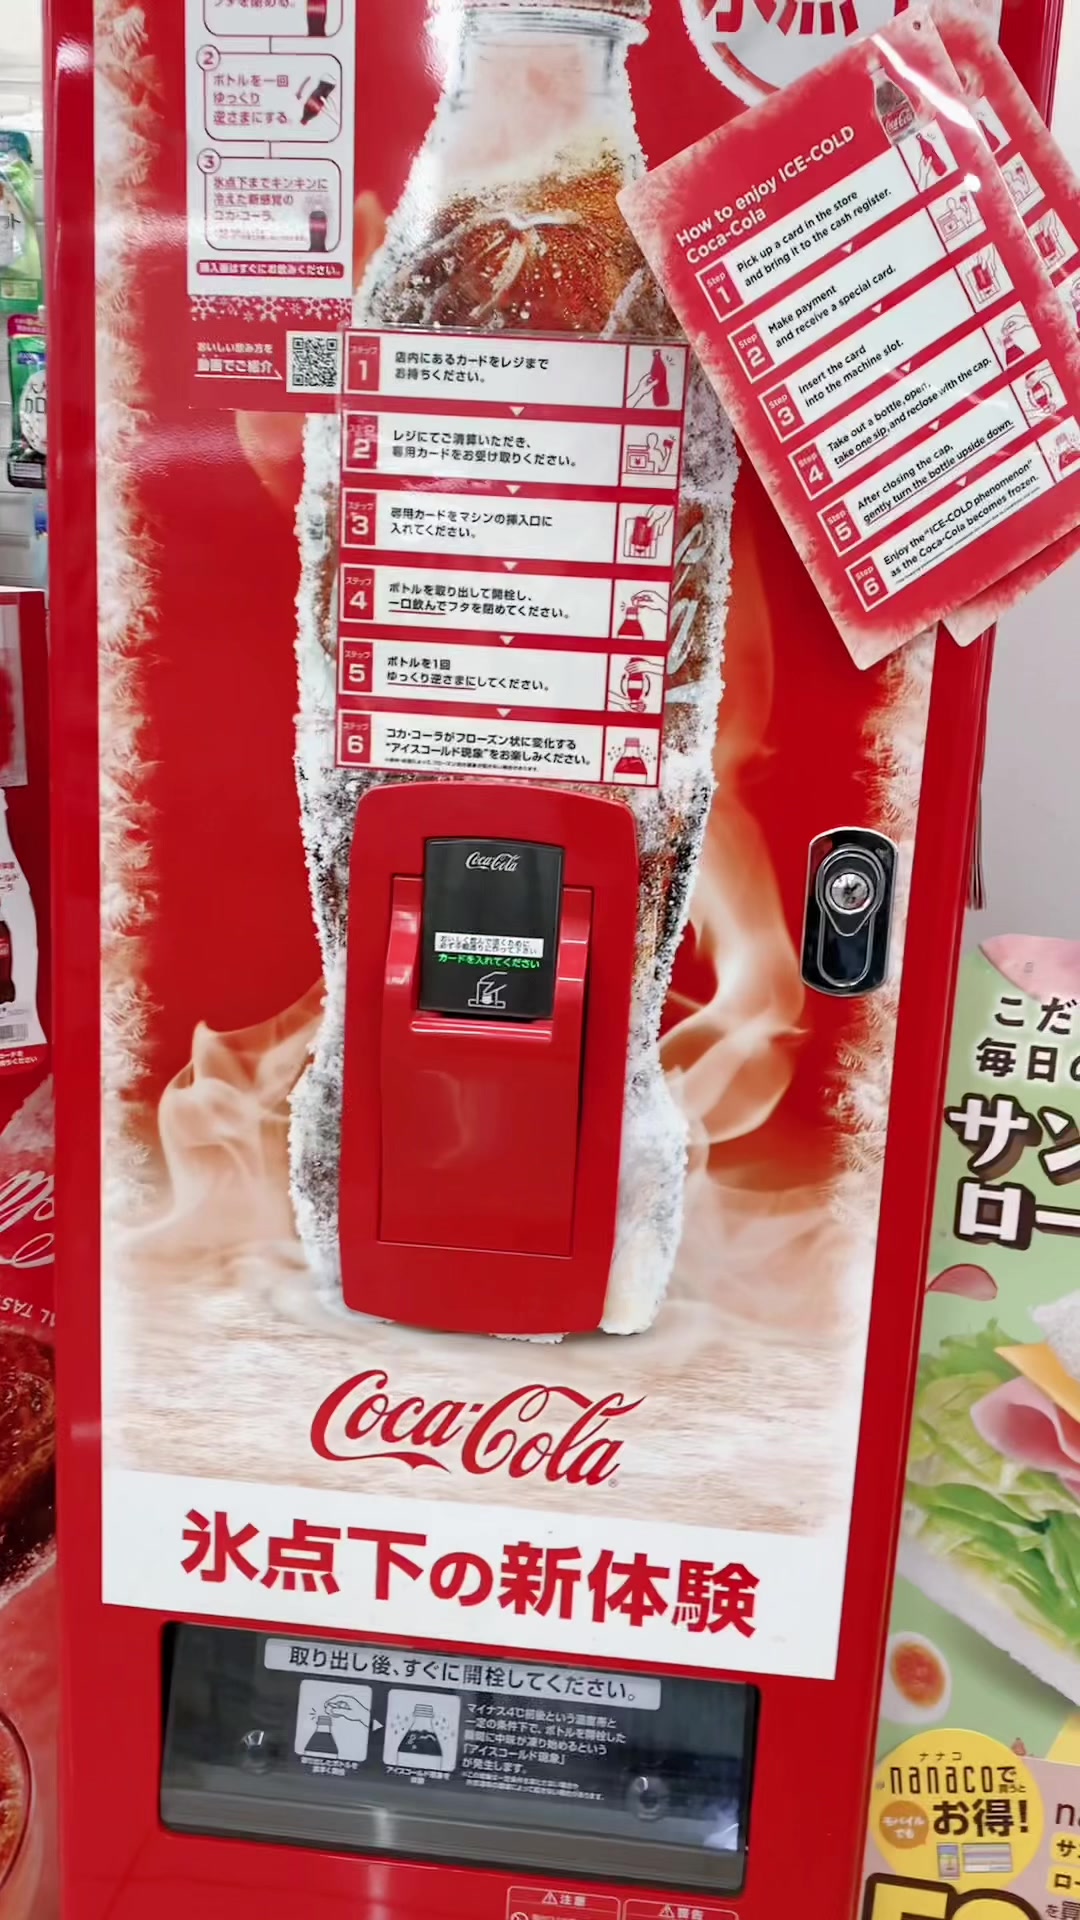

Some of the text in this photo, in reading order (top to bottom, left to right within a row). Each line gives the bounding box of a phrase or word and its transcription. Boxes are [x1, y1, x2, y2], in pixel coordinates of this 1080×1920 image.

[203, 51, 214, 65] 2
[213, 75, 289, 87] ボトルを一回
[213, 92, 260, 104] ゆっくり
[203, 155, 215, 169] 3
[214, 176, 329, 190] 氷点下までキンキンに
[675, 125, 854, 247] How to enjoy ICE-COLD
[686, 207, 766, 263] Coca-Cola
[735, 191, 857, 272] Pick up a card in the store
[744, 188, 891, 287] and bring it to the cash register.
[706, 271, 726, 288] Step
[716, 285, 731, 303] 1
[767, 284, 837, 334] Make payment
[775, 263, 896, 348] and receive a special card.
[737, 333, 758, 349] Step
[395, 351, 549, 370] 店内にあるカードをレジまで
[746, 345, 765, 367] 2
[358, 360, 368, 381] 1
[395, 367, 487, 384] お持ちください。
[797, 344, 866, 394] Insert the card
[804, 339, 904, 407] into the machine slot.
[767, 393, 788, 409] Step
[833, 357, 992, 465] take one sip, and reclose with the cap.
[776, 405, 795, 426] 3
[826, 434, 849, 451] Take
[850, 421, 866, 437] out
[867, 418, 874, 426] a
[873, 399, 906, 421] bottle,
[352, 438, 371, 460] 2
[392, 446, 576, 468] 専用カードをお受け取りください。
[797, 451, 818, 468] Step
[808, 464, 823, 483] 4
[857, 443, 954, 510] After closing the cap,
[862, 419, 1013, 524] gently turn the bottle upside down.
[351, 516, 369, 536] 3
[390, 507, 553, 528] 専用カードをマシンの挿入口に
[826, 509, 846, 525] Step
[890, 474, 1037, 577] as the Coca-Cola becomes frozen.
[390, 524, 477, 540] 入れてください。
[834, 520, 852, 541] 5
[882, 544, 909, 565] Enjoy
[908, 534, 925, 548] the
[345, 576, 373, 586] ステップ
[854, 565, 874, 581] Step
[388, 582, 533, 602] ボトルを取り出して開栓し、
[863, 576, 879, 596] 6
[350, 591, 368, 610] 4
[388, 598, 571, 620] 一口飲んでフタを閉めてください。
[344, 649, 371, 659] ステップ
[387, 656, 451, 671] ボトルを1回
[349, 664, 366, 682] 5
[387, 671, 550, 692] ゆっくり逆さまにしてください。
[343, 722, 369, 731] ステップ
[347, 735, 365, 754] 6
[465, 851, 521, 872] Coca-Cola
[438, 953, 540, 968] カードを入れてください
[310, 1369, 648, 1487] Coca-Cola
[180, 1508, 761, 1639] 氷点下の新体験
[289, 1645, 639, 1703] 取り出し後、すぐに開栓してください。
[462, 1758, 527, 1774] が発生します。
[919, 1752, 962, 1761] ナナコ
[883, 1815, 926, 1826] モバイル
[895, 1828, 914, 1839] でも
[559, 1894, 587, 1907] 注意
